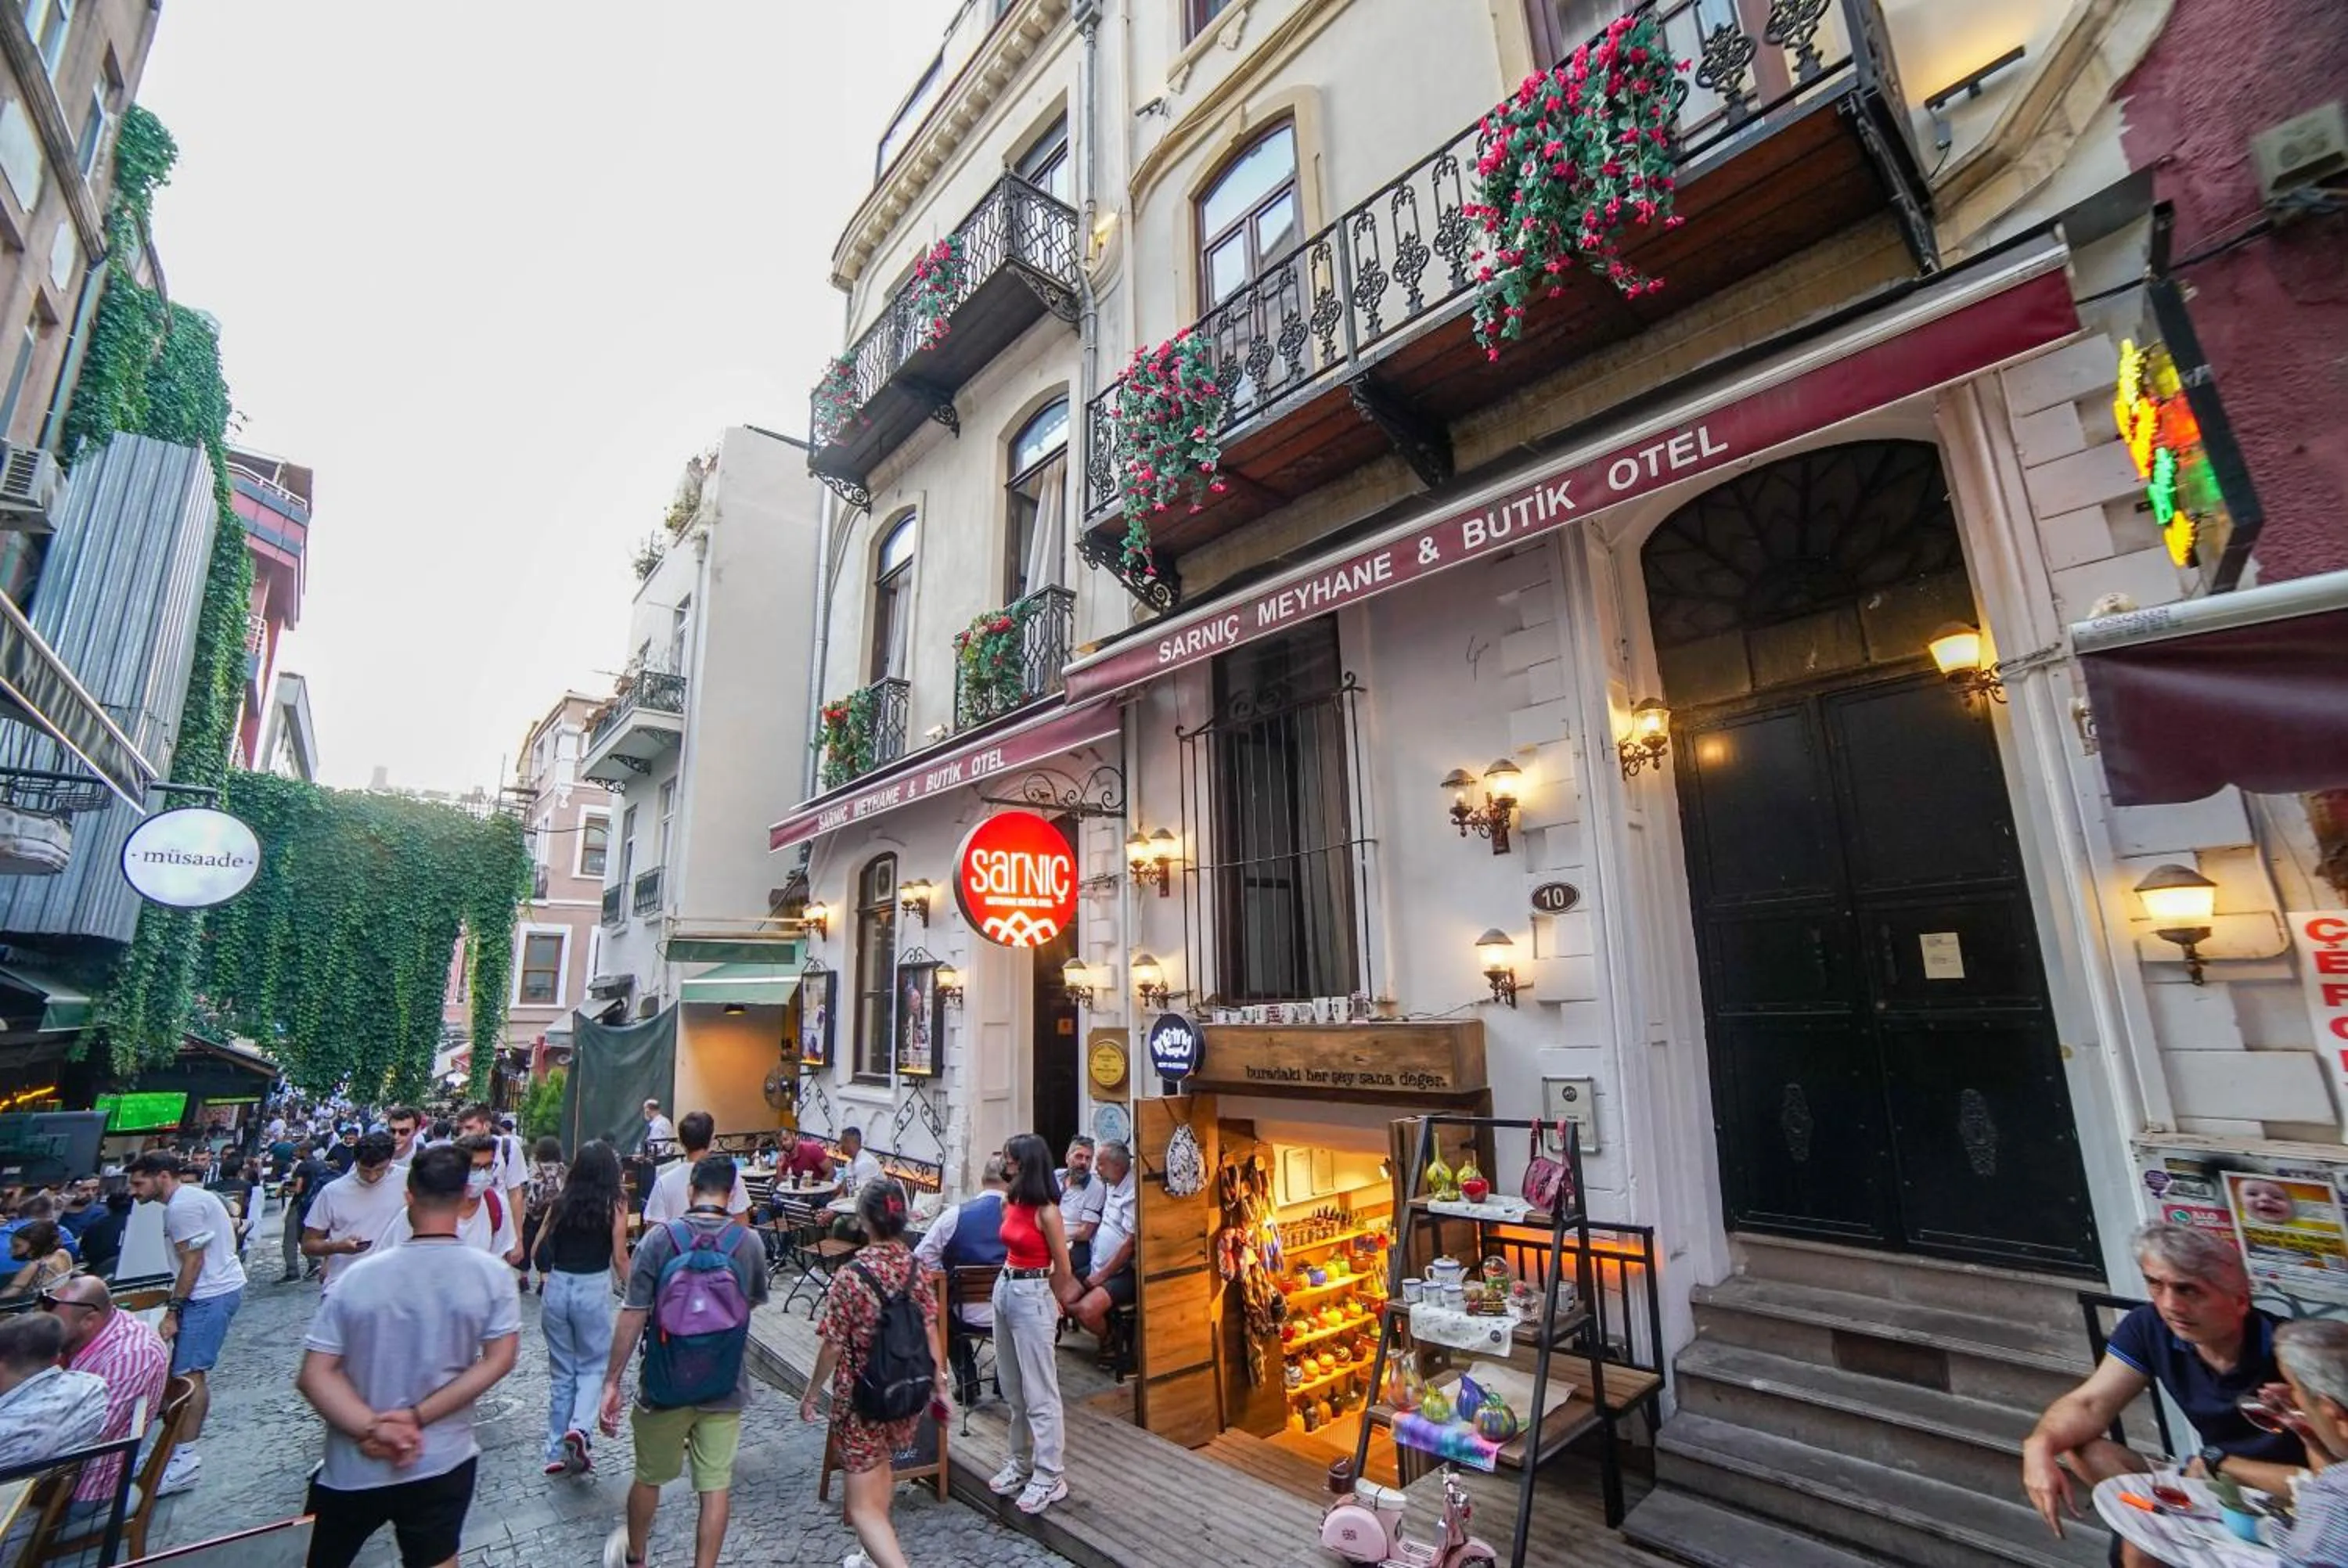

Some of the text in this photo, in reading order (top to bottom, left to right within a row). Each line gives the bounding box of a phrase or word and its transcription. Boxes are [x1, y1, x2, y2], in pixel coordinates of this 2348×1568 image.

[1158, 425, 1729, 664] SARNIÇ MEYHANE & BUTİK OTEL
[853, 786, 902, 818] MEYHANE
[907, 781, 916, 798] &
[926, 761, 963, 793] BUTİK
[971, 748, 1005, 775] OTEL
[144, 849, 244, 868] müsaade
[1542, 887, 1565, 908] 10
[1305, 1066, 1329, 1083] her
[1359, 1072, 1395, 1087] sana
